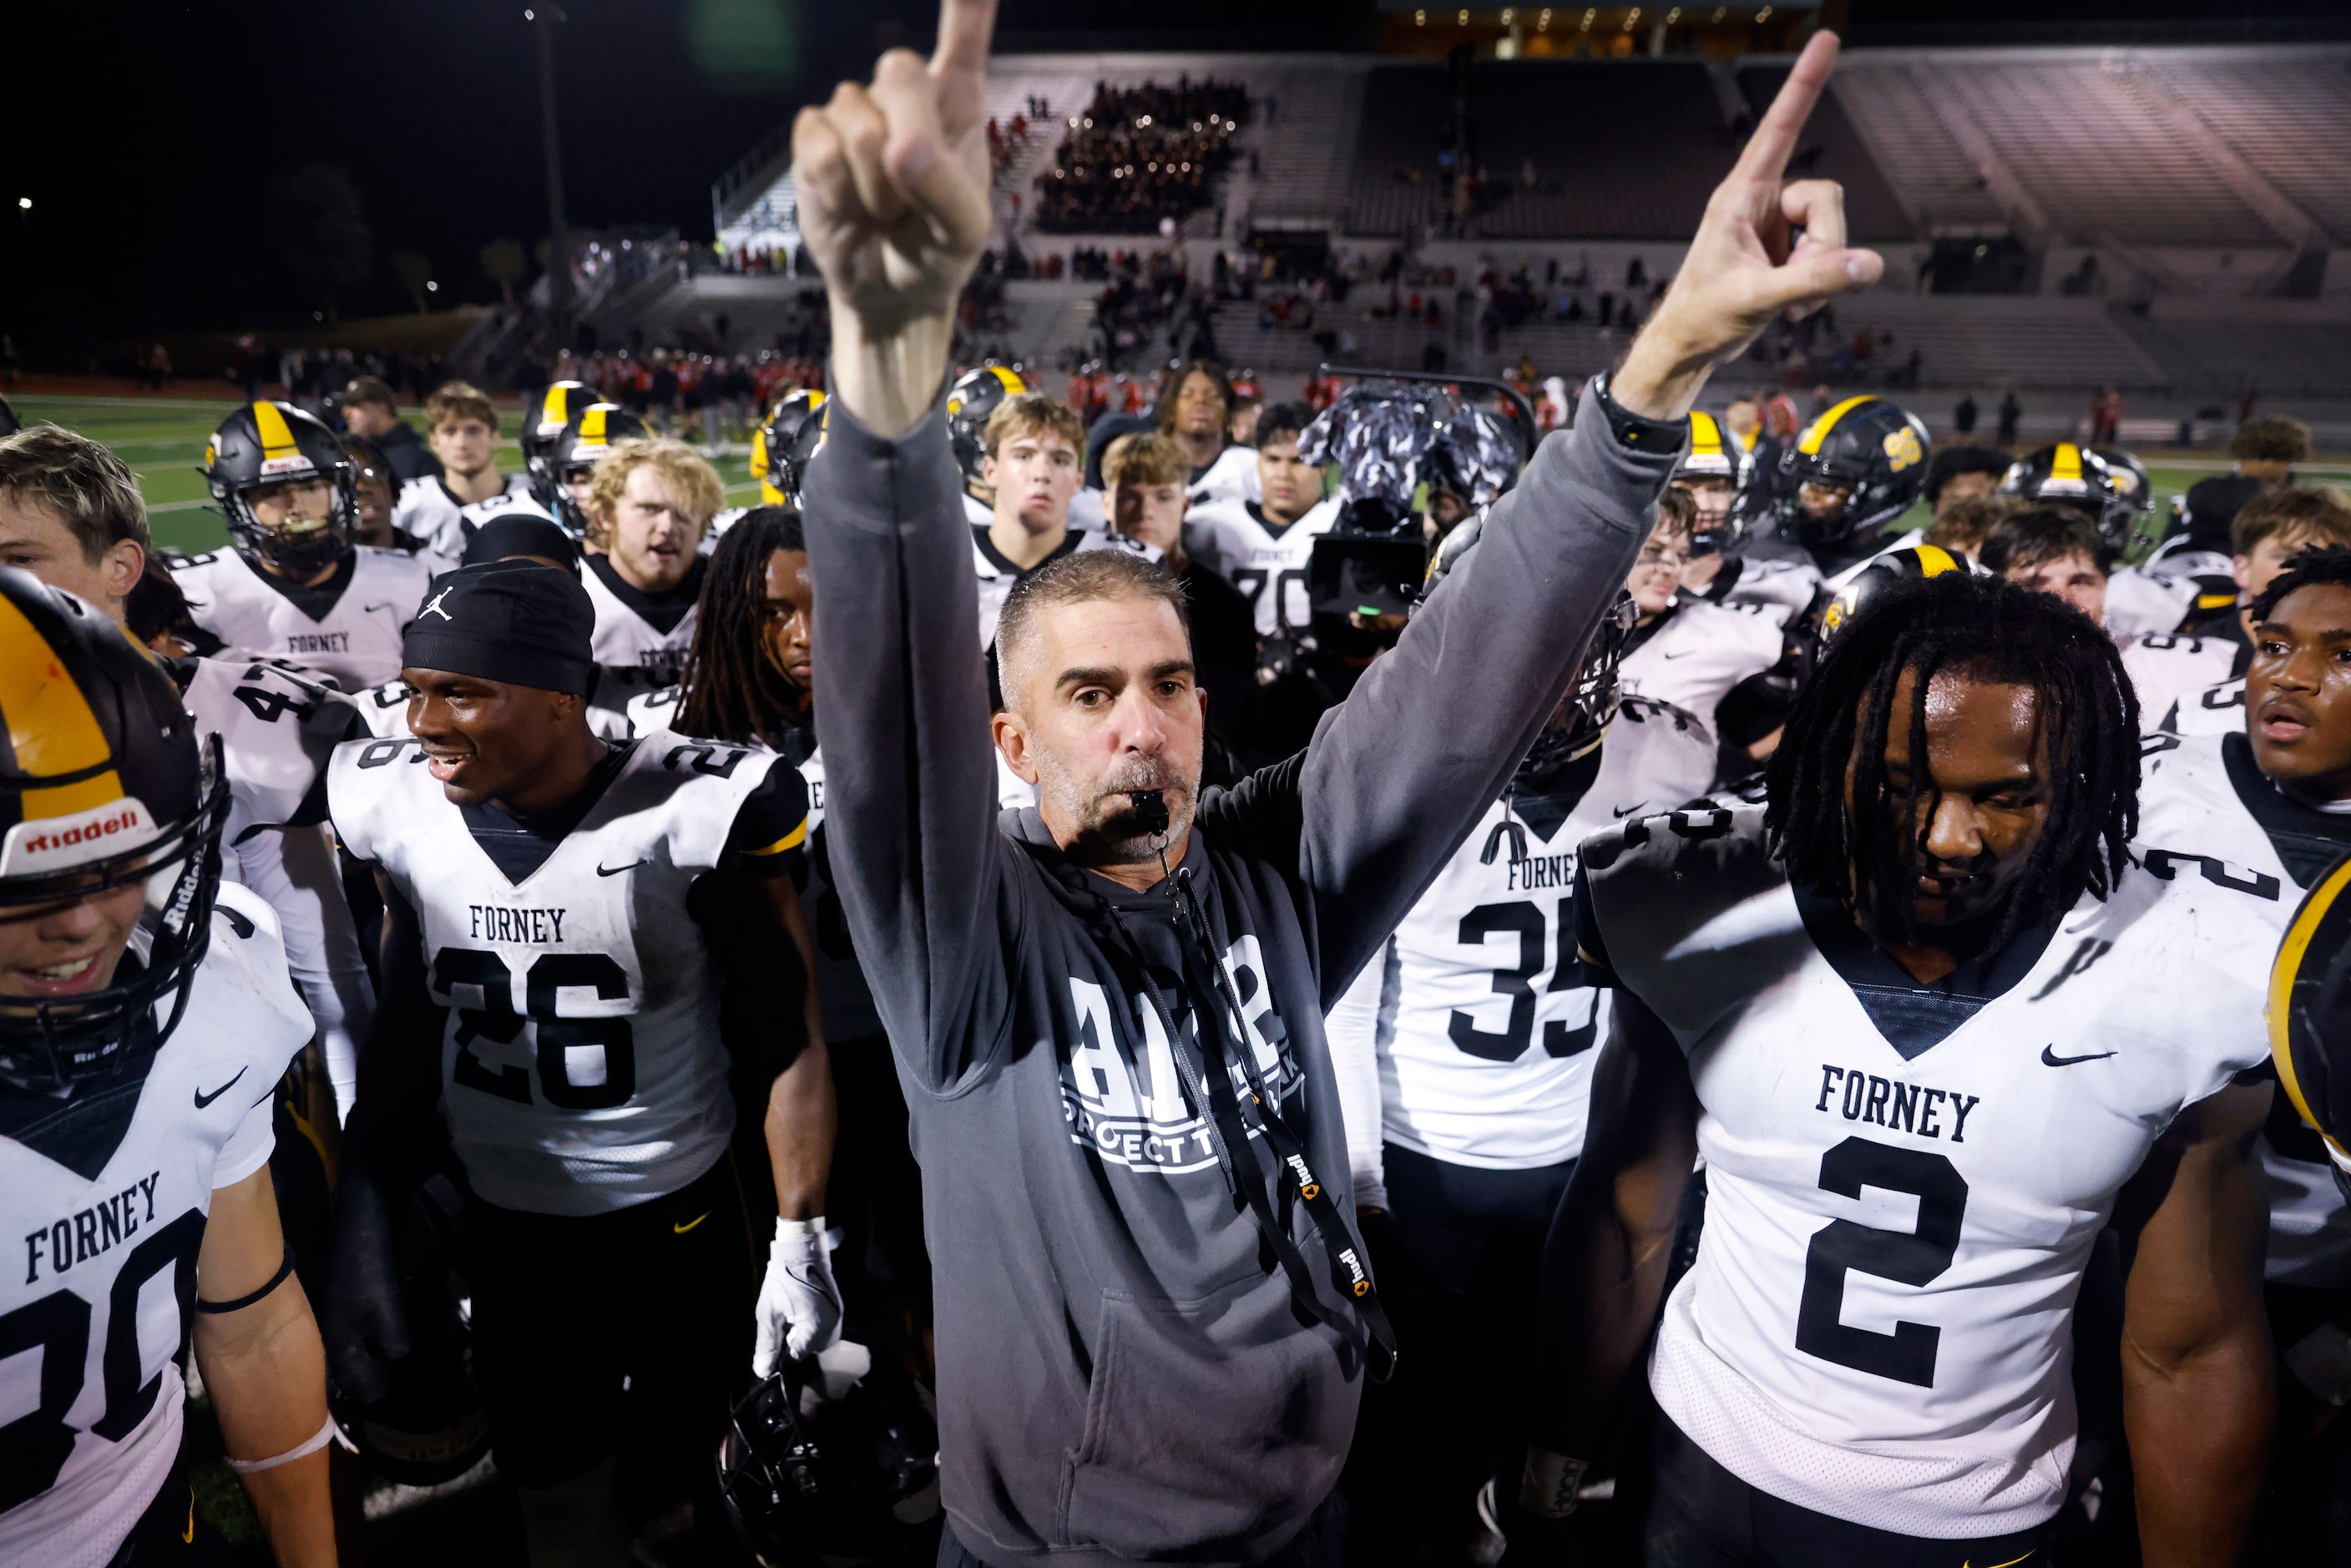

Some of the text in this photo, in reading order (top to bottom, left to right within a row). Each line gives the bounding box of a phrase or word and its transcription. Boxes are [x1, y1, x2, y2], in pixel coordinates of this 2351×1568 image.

[1883, 426, 1923, 473] 96
[1252, 548, 1293, 564] FORNEY
[287, 631, 349, 653] FORNEY
[1508, 854, 1578, 891] FORNE
[469, 905, 566, 943] FORNEY
[1449, 900, 1600, 1062] 35
[432, 947, 635, 1110] 26
[1816, 1064, 1979, 1142] FORNEY
[1287, 1153, 1314, 1188] hudl
[25, 1171, 159, 1285] FORNEY
[1339, 1247, 1365, 1285] hudl
[1796, 1136, 1969, 1388] 2
